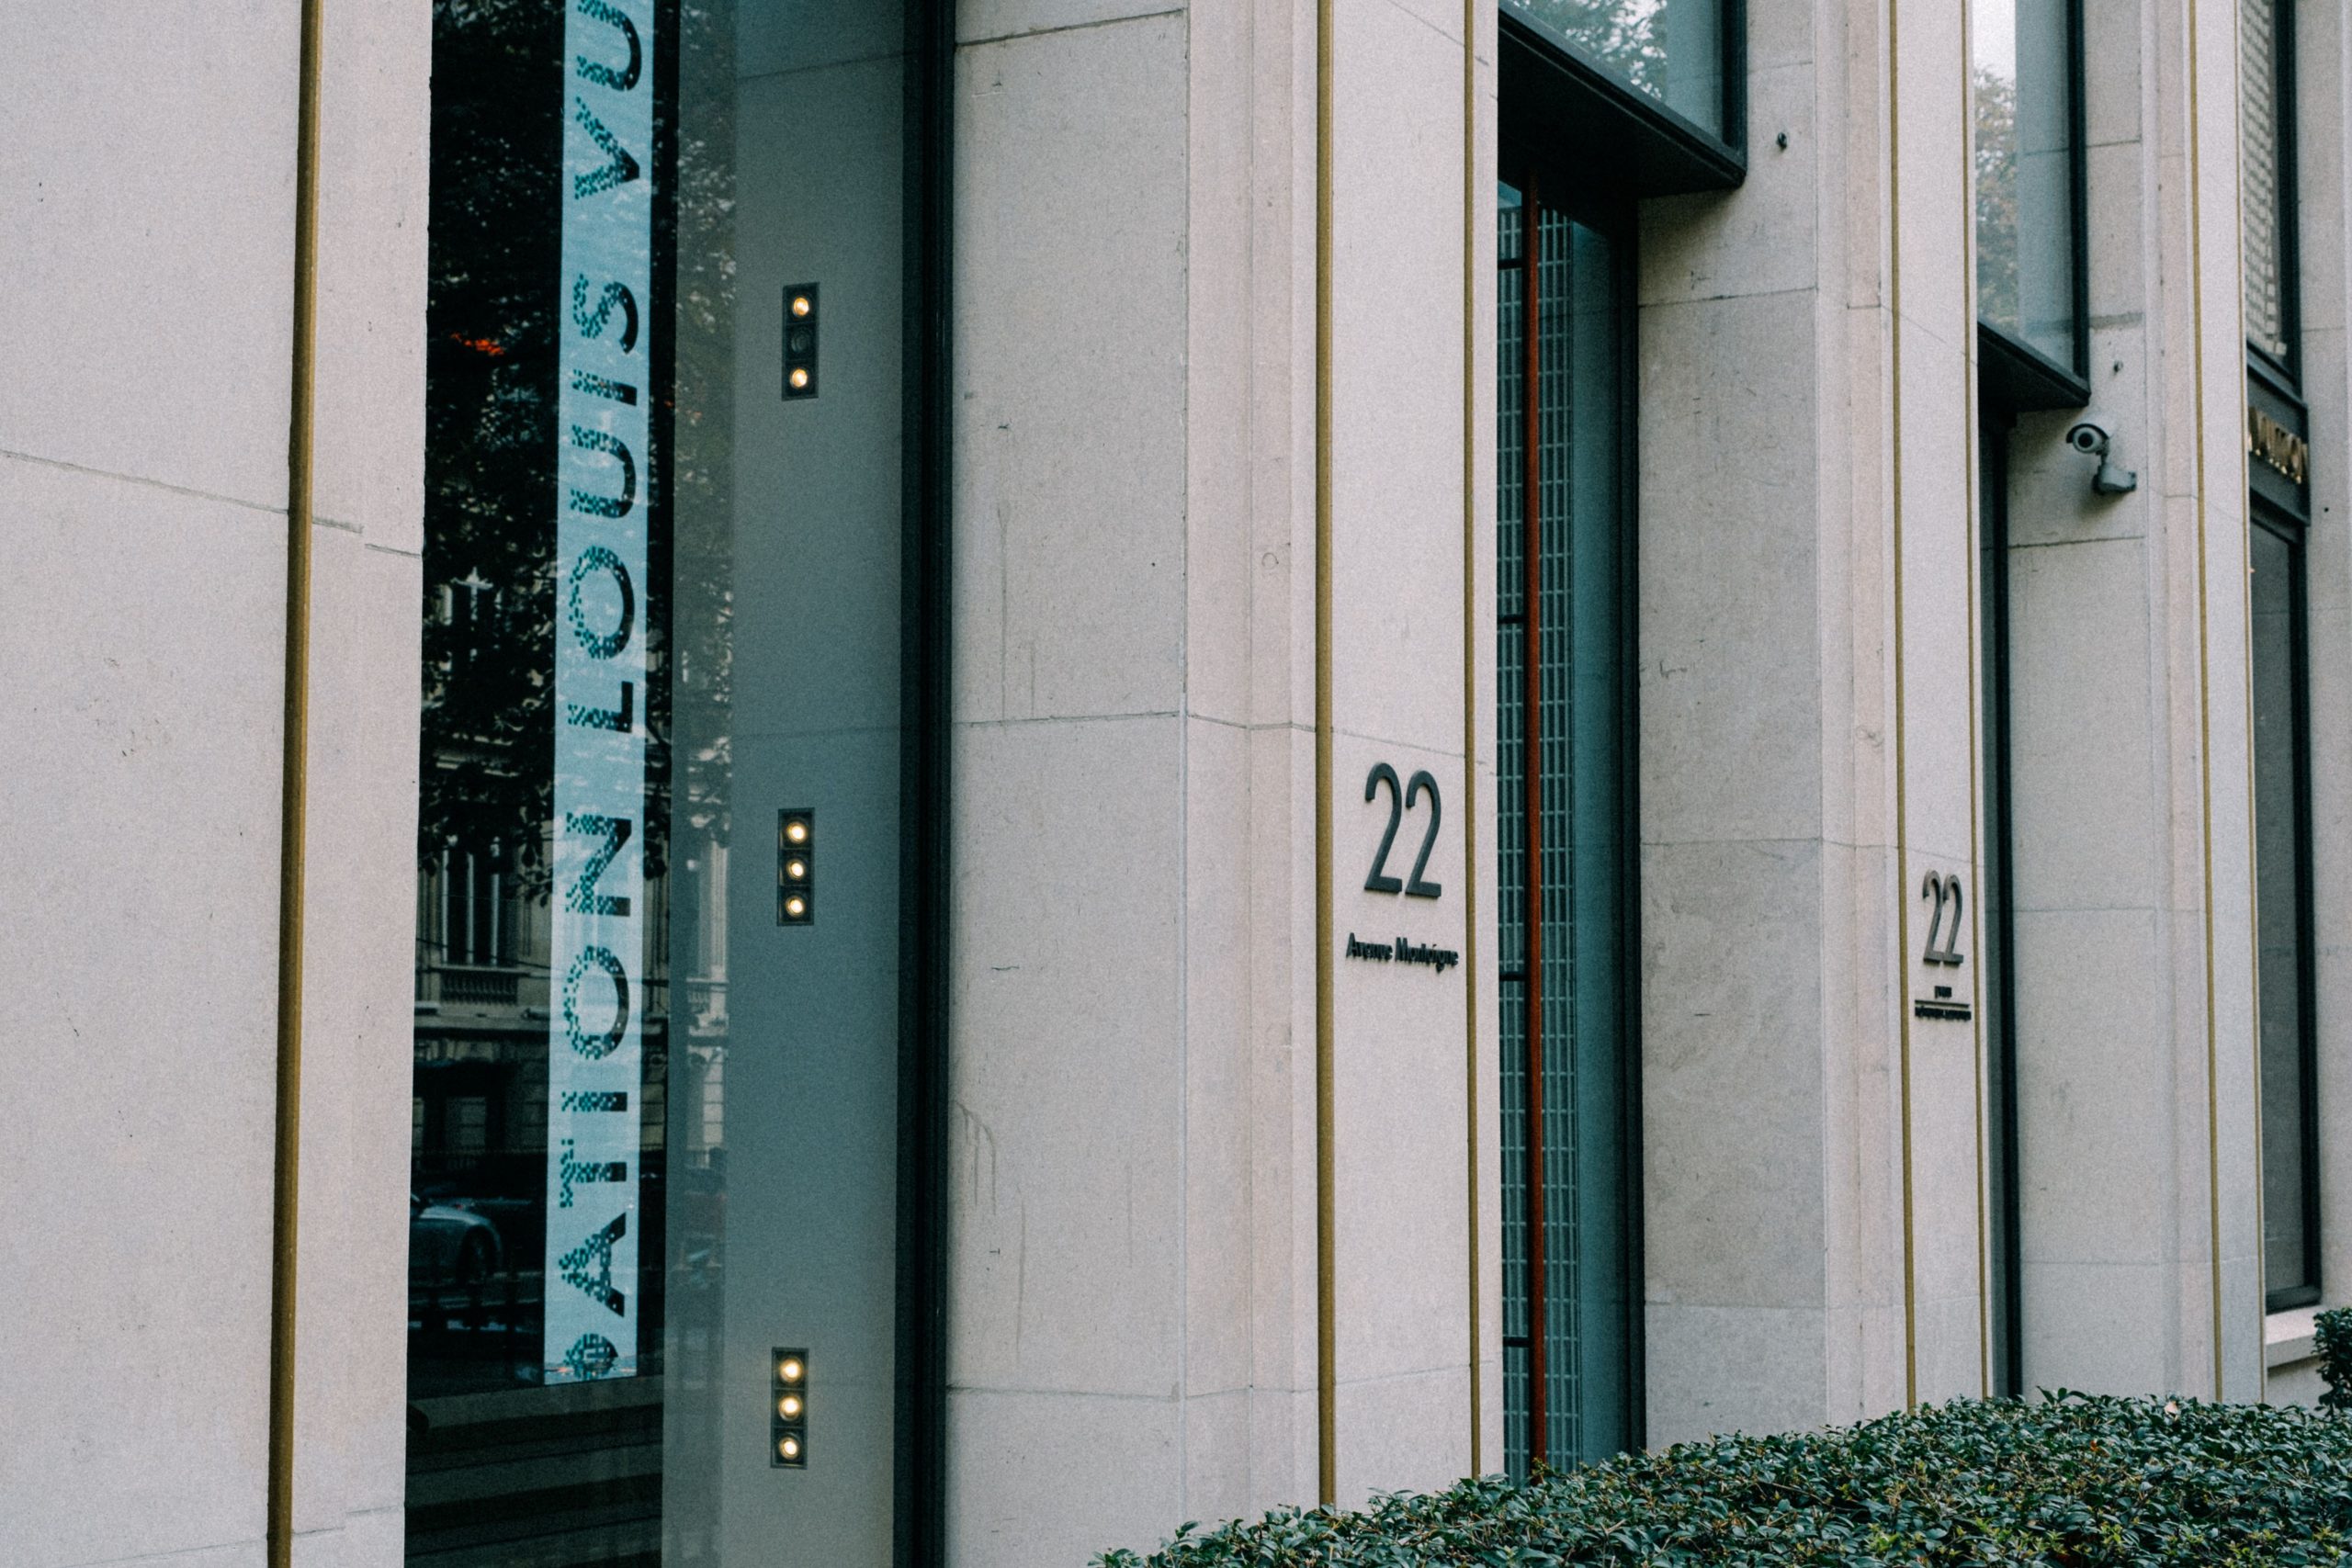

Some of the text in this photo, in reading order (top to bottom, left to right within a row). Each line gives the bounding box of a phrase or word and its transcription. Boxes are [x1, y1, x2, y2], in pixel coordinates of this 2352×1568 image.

[567, 273, 639, 734] LOUIS
[1364, 761, 1442, 898] 22
[1346, 932, 1393, 961] Avenue
[1922, 870, 1963, 967] 22
